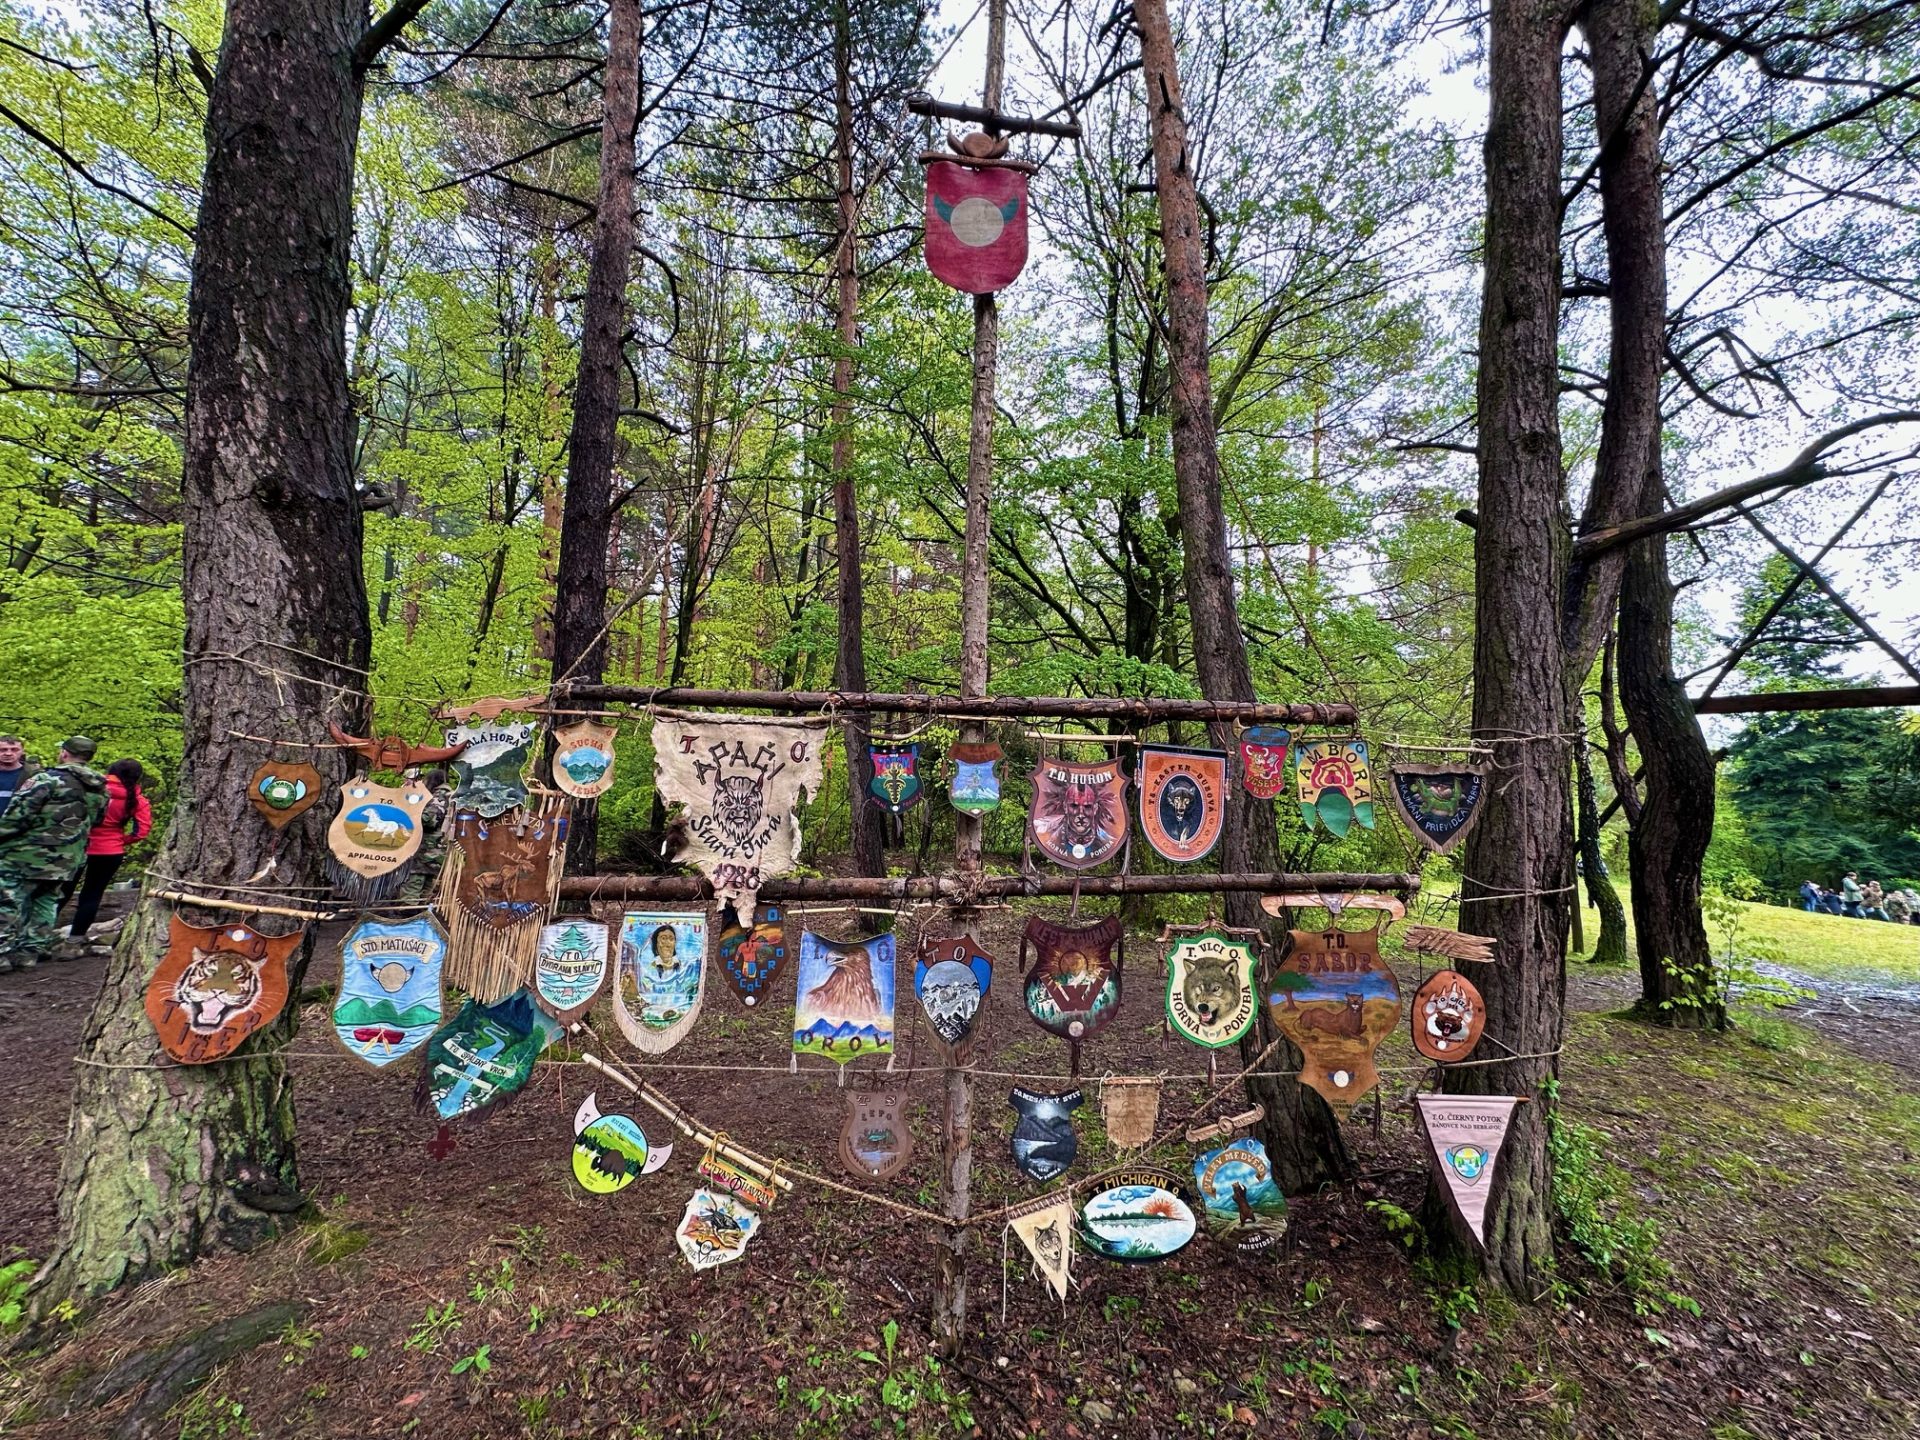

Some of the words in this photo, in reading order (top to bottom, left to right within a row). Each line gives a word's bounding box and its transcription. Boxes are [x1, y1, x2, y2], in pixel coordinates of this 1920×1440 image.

[489, 733, 520, 747] HORA
[679, 735, 699, 755] T.
[790, 740, 811, 763] O.
[1070, 771, 1113, 785] HURON
[1299, 744, 1370, 800] TAMBORA
[1425, 810, 1468, 832] PRIEVIDZA
[1090, 840, 1115, 858] PORUBA
[347, 852, 397, 863] APPALOOSA
[1199, 942, 1226, 955] VLCI
[1322, 933, 1349, 950] T.O.
[541, 959, 571, 975] DVORANA
[1297, 952, 1374, 973] SABOR
[1223, 984, 1252, 1036] PORUBA
[161, 1000, 262, 1062] TIGER
[800, 1031, 889, 1052] OROL
[489, 1065, 507, 1077] VRCH
[1062, 1090, 1081, 1102] SVIT
[1476, 1115, 1502, 1123] POTOK
[1104, 1174, 1168, 1190] MICHIGAN
[741, 1182, 772, 1204] HAVRAN
[1238, 1236, 1275, 1251] PRIEVIDZA
